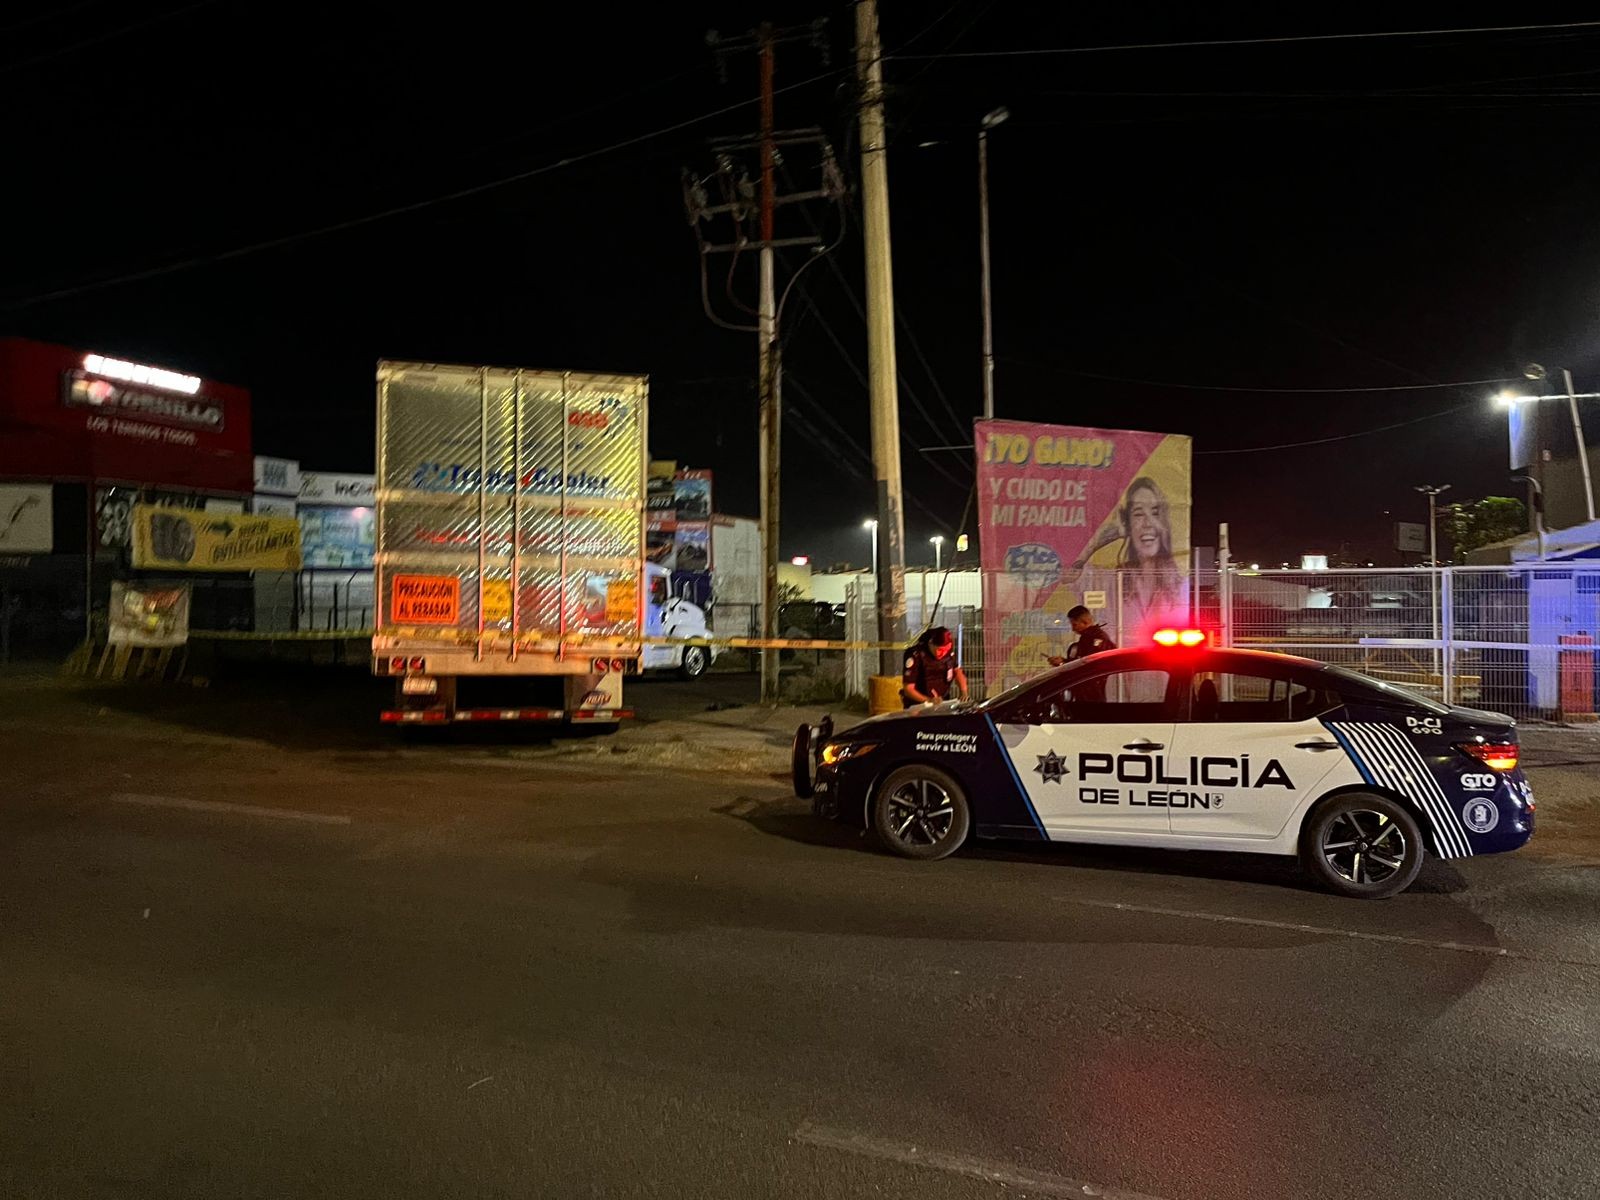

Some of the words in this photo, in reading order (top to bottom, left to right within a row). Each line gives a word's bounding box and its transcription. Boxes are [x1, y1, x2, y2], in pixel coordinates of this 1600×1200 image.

[990, 478, 1004, 499] Y
[1006, 478, 1062, 500] CUIDO
[1065, 480, 1087, 501] DE
[991, 504, 1014, 526] MI
[1017, 505, 1086, 527] FAMILIA
[916, 742, 941, 751] servir
[950, 742, 977, 753] LEÓN
[917, 731, 935, 740] Para
[935, 733, 971, 743] proteger
[1079, 753, 1296, 790] POLICÍA
[1460, 773, 1497, 788] GTO
[1079, 787, 1119, 805] DE
[1129, 789, 1210, 809] LEÓN
